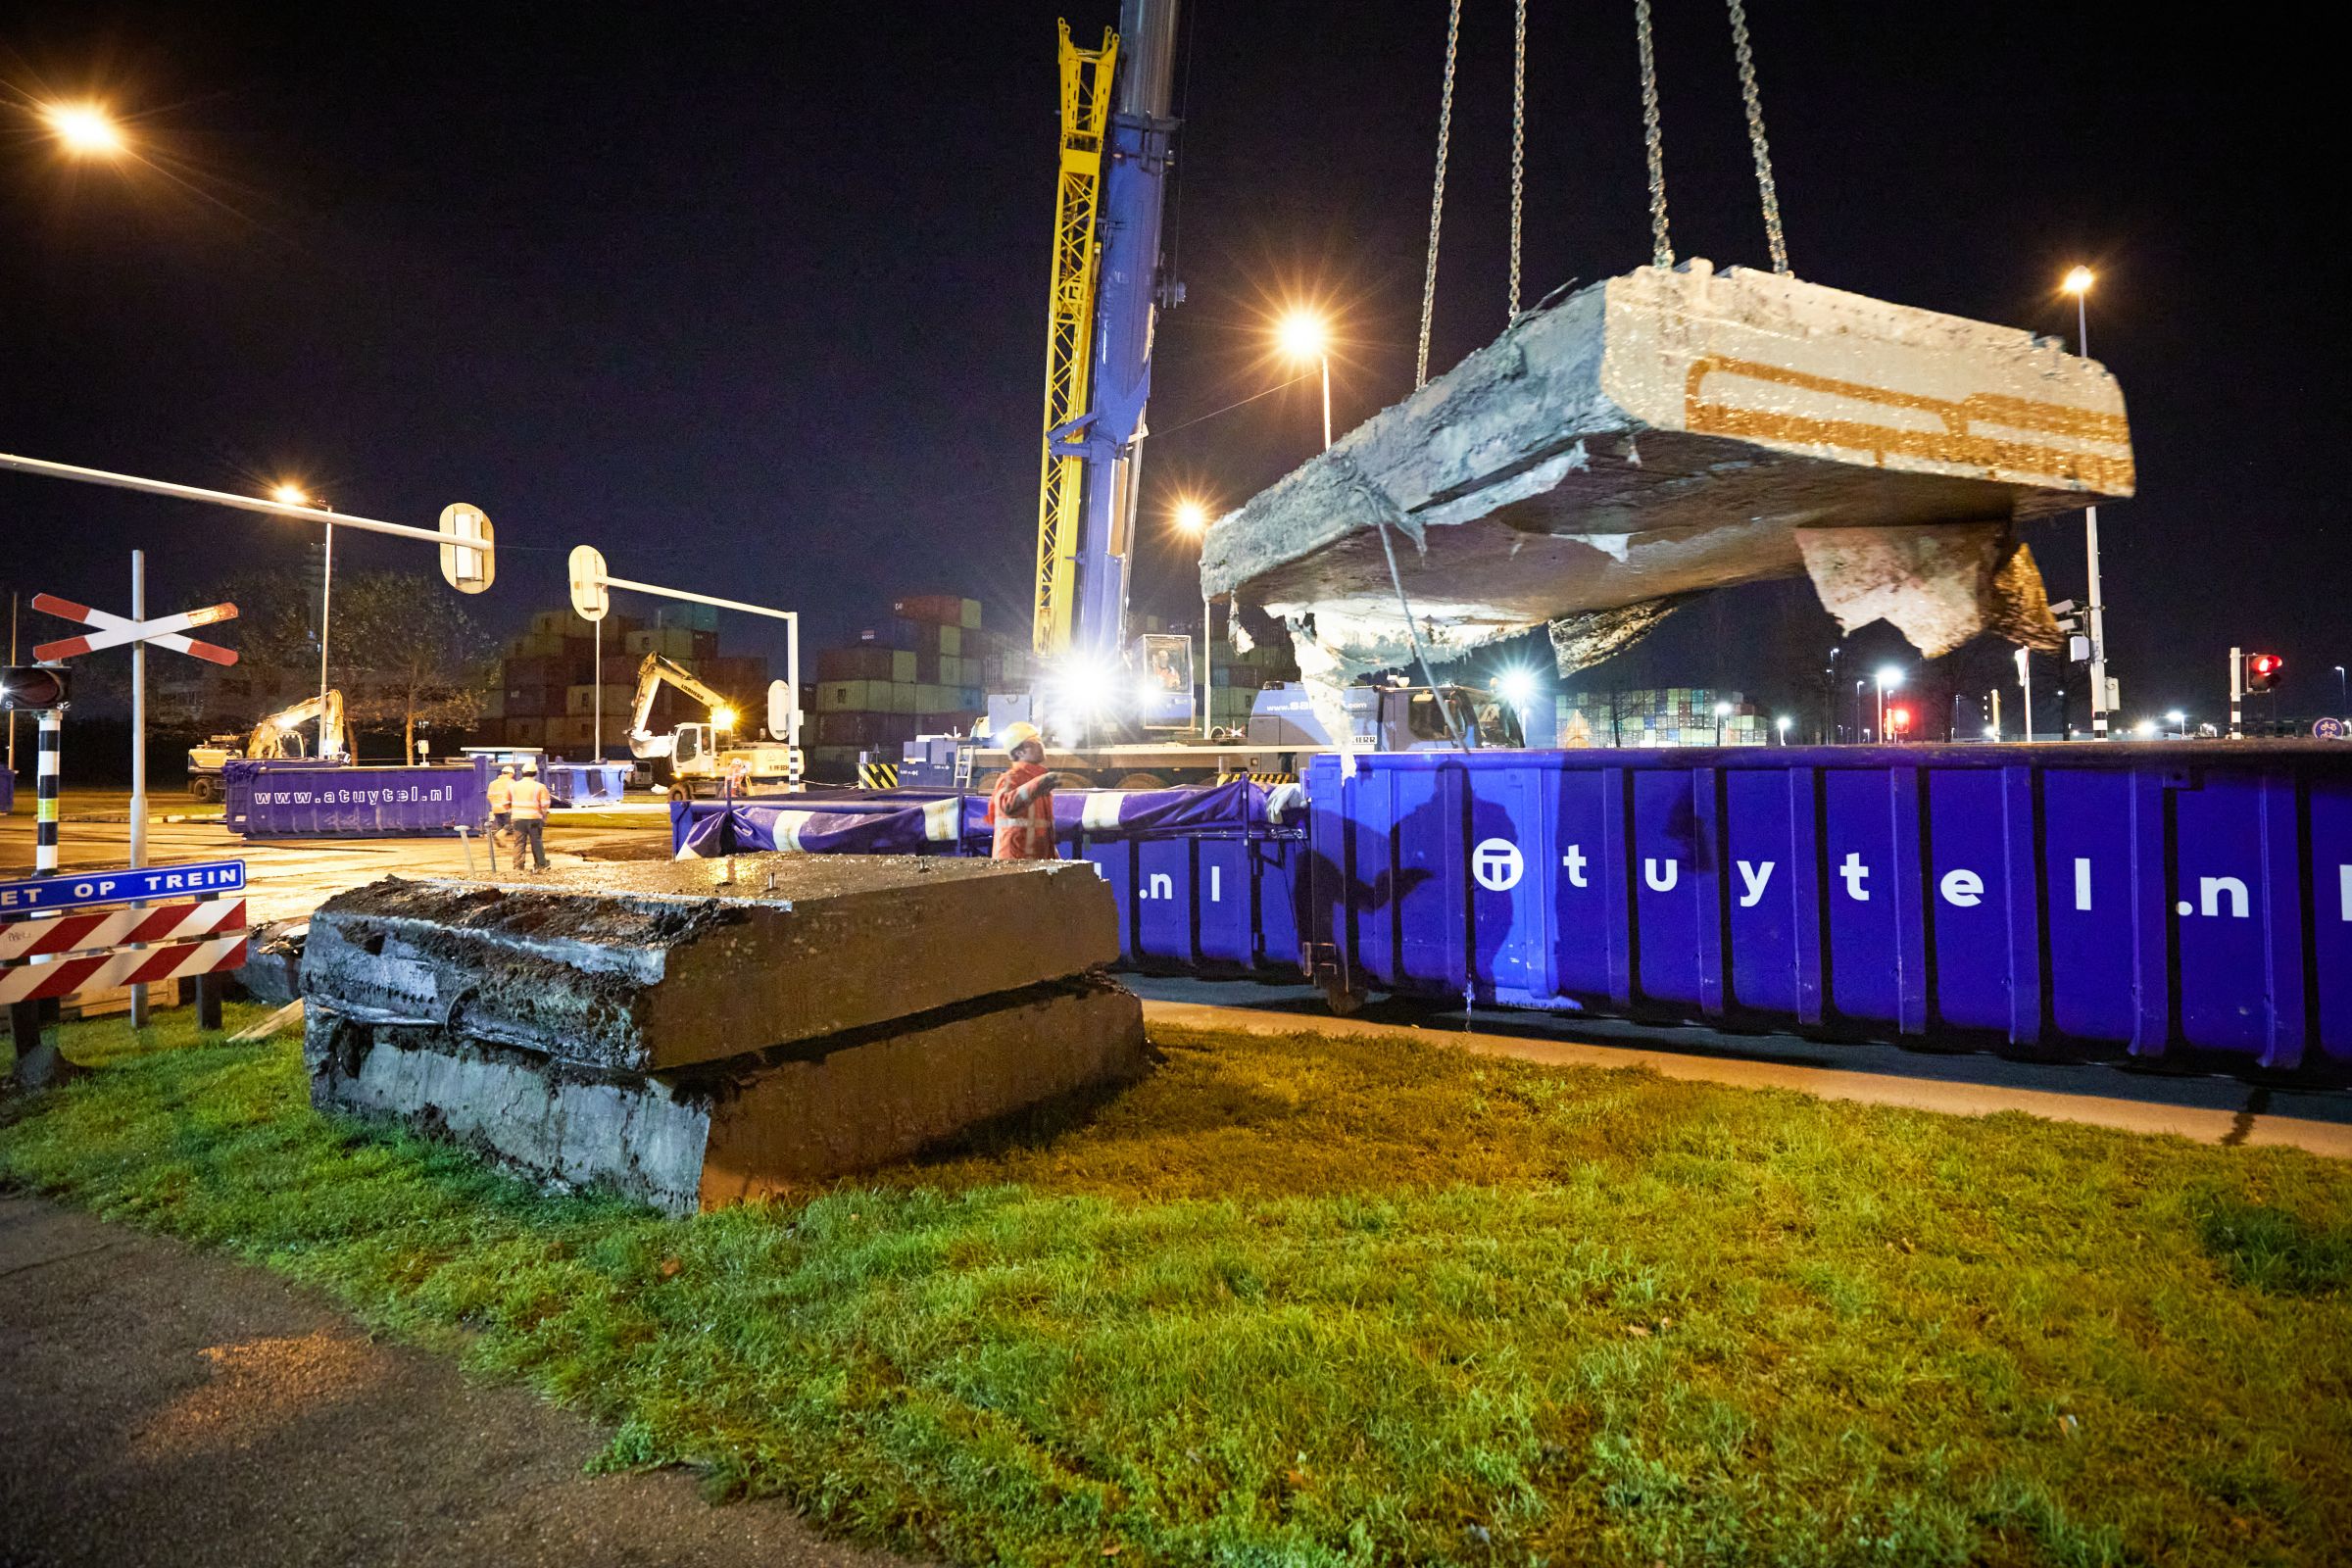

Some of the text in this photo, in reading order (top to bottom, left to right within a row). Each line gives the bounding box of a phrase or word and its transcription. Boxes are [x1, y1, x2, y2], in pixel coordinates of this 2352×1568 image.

[254, 785, 452, 806] www.atuytel.nl
[74, 881, 116, 898] OP
[145, 868, 236, 891] TREIN
